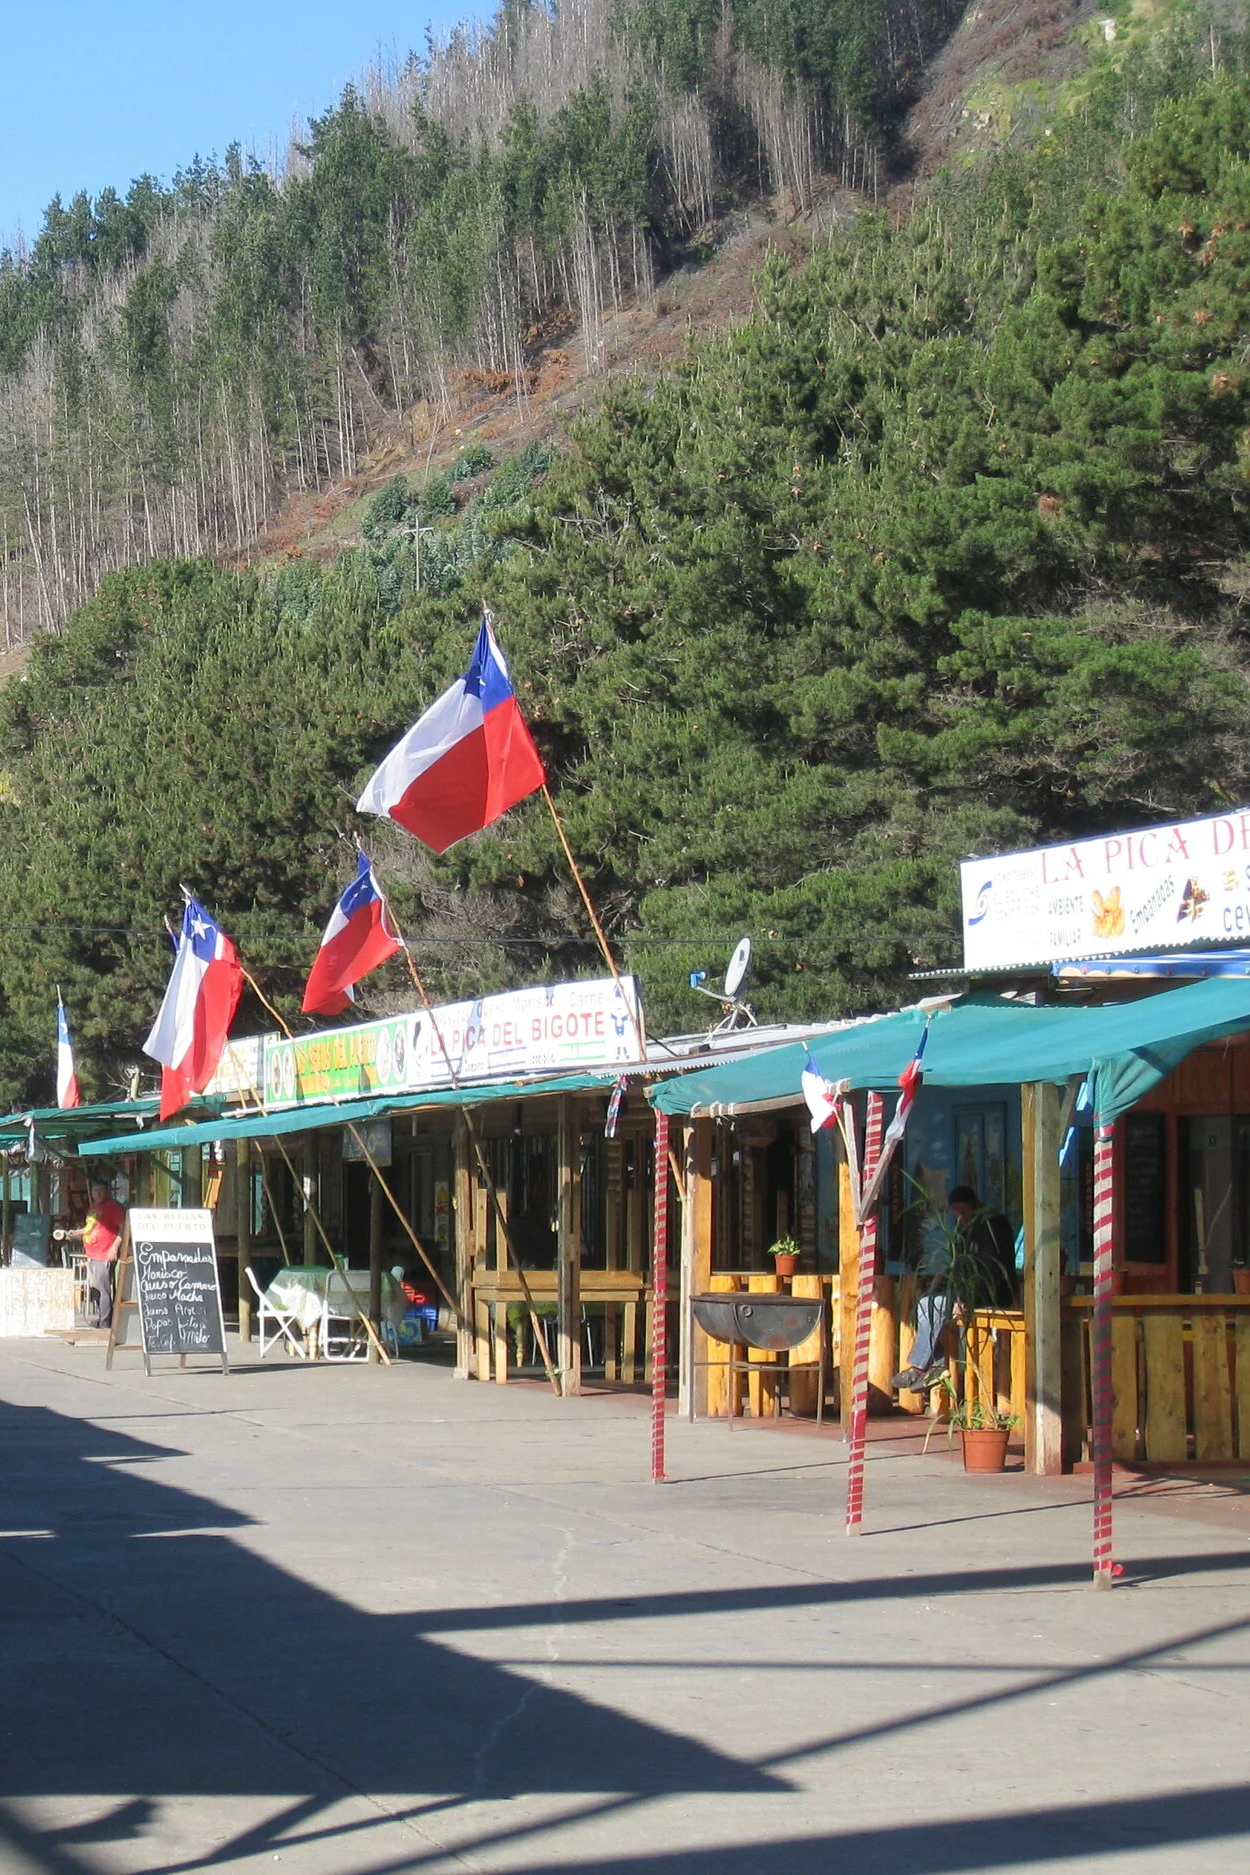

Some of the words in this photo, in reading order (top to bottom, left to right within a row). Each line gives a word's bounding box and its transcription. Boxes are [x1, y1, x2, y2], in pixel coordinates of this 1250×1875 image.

[1041, 847, 1085, 885] LA
[1104, 828, 1190, 874] PICA
[1048, 895, 1085, 916] AMBIENTE
[1129, 873, 1177, 935] Empanadas
[1049, 928, 1082, 947] FAMILIAR
[452, 1022, 488, 1055] PICA
[492, 1021, 523, 1047] DEL
[531, 1011, 606, 1041] BIGOTE
